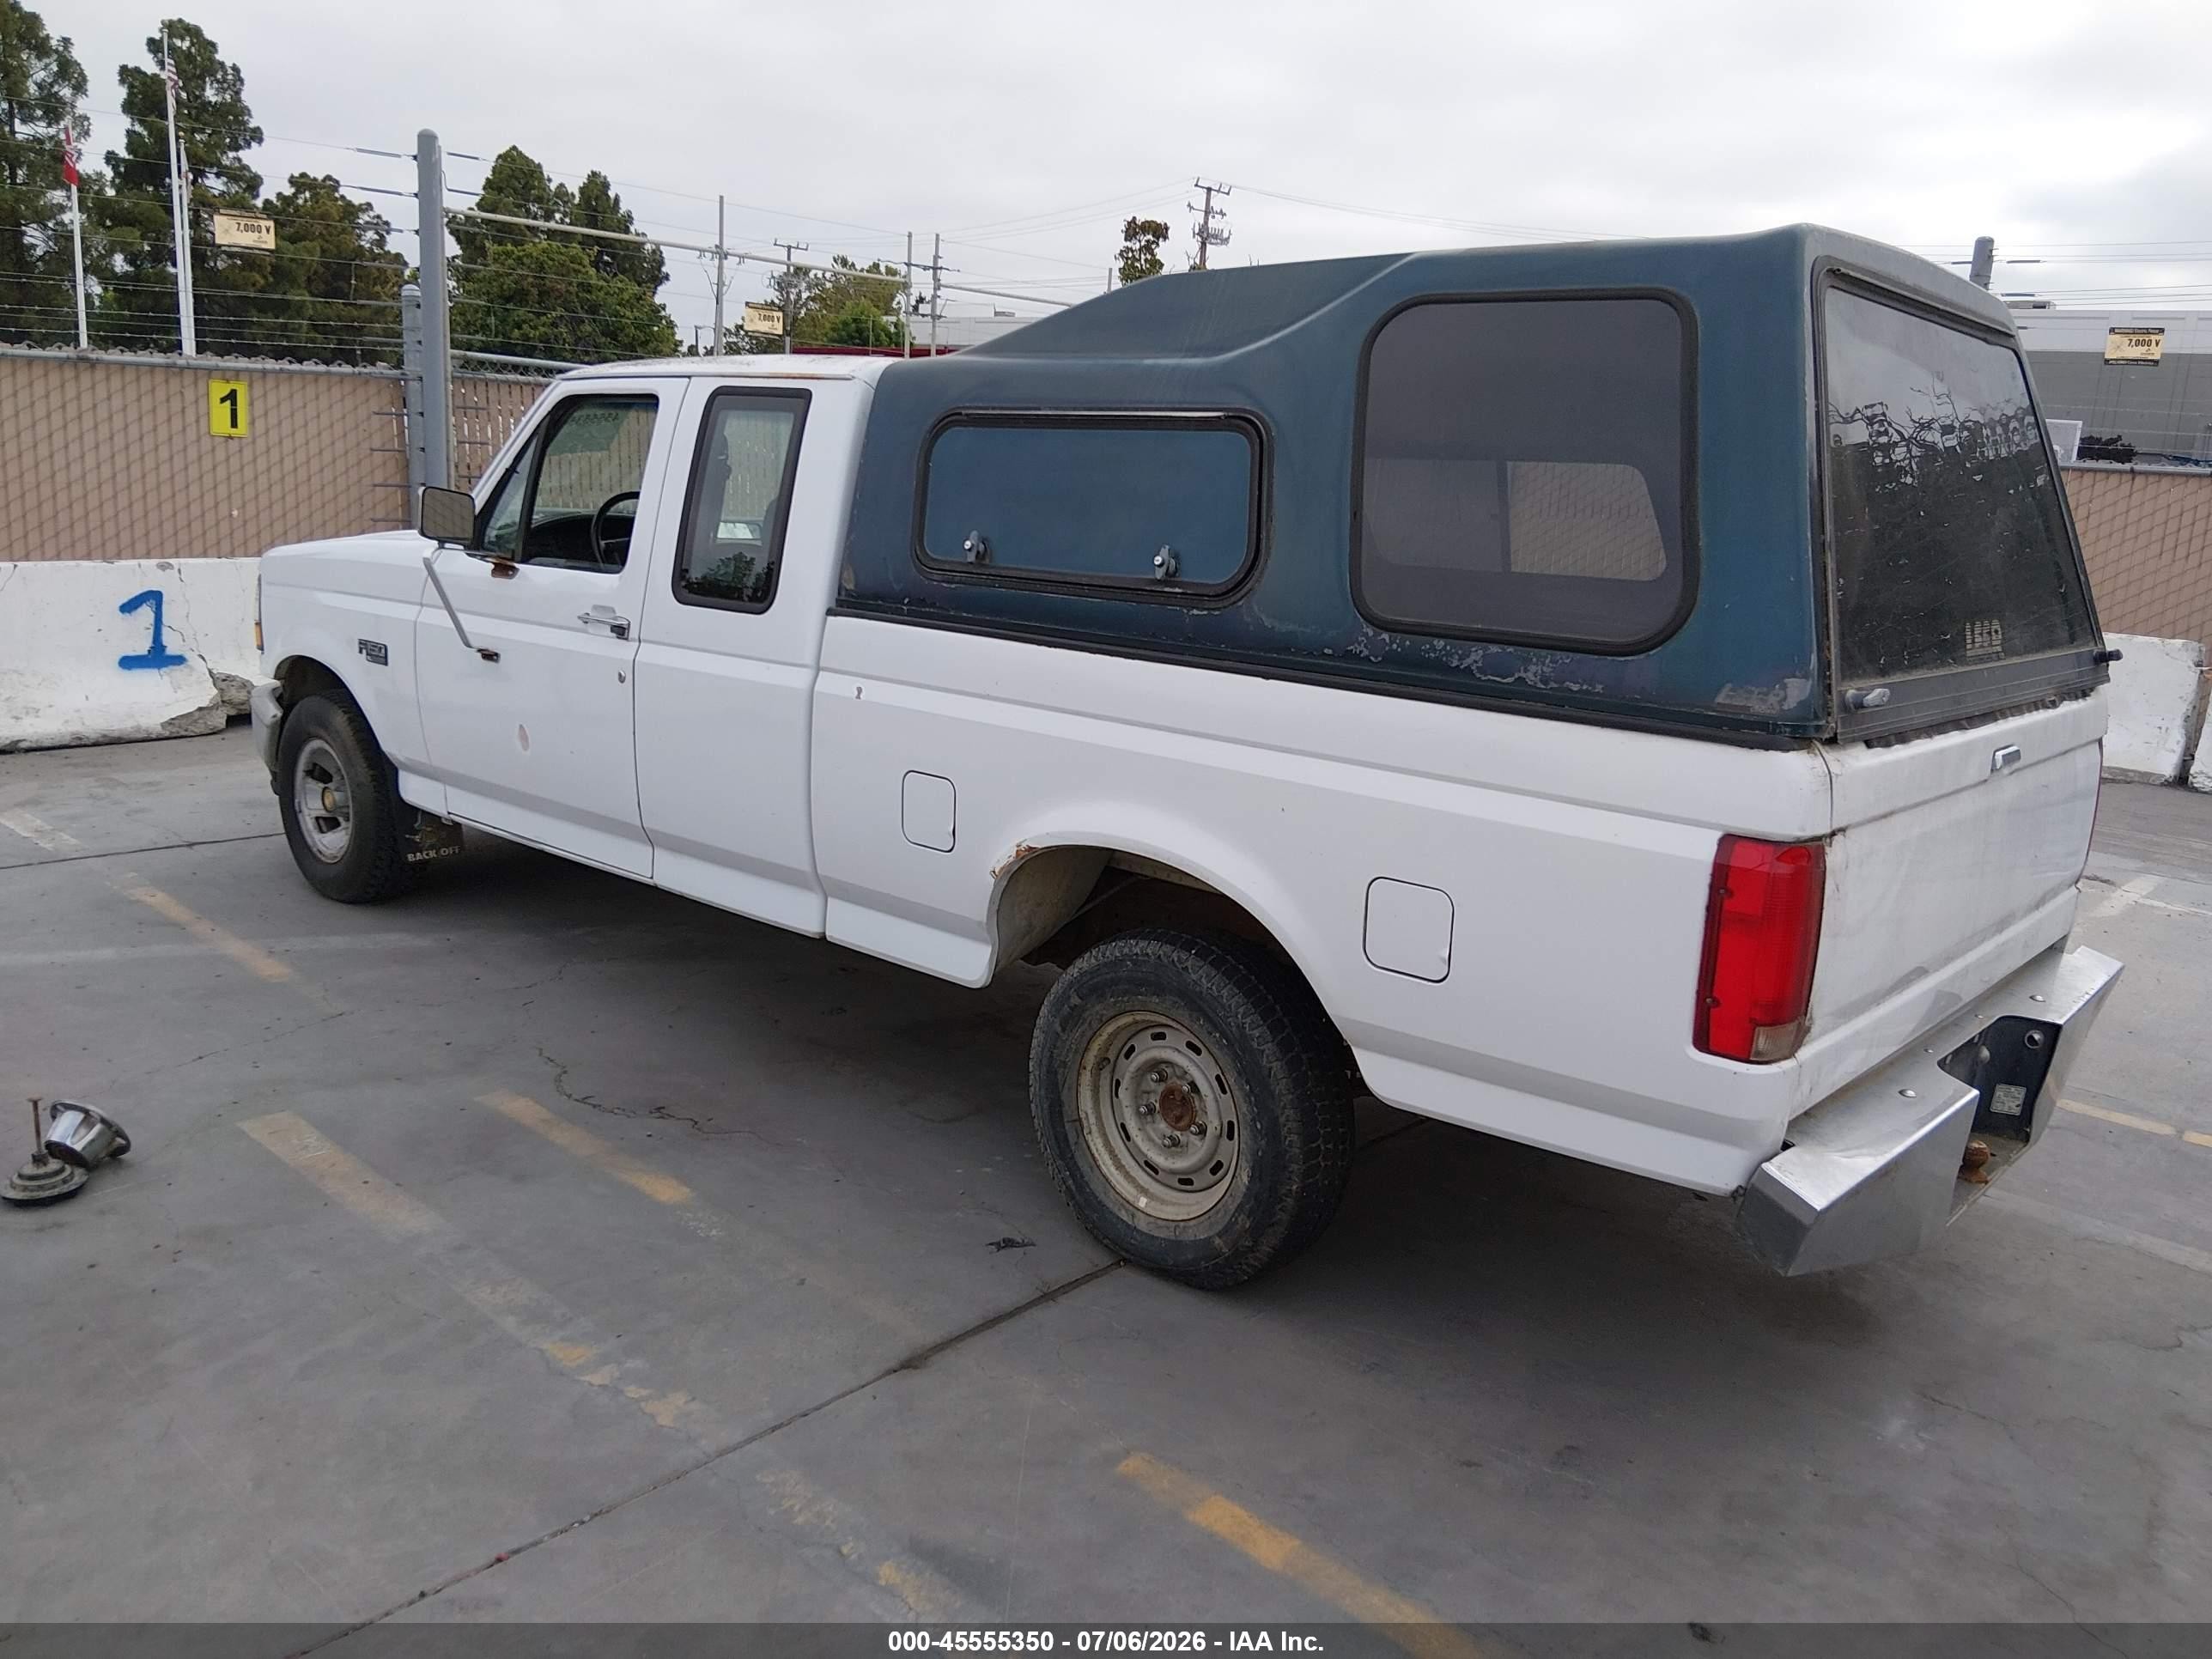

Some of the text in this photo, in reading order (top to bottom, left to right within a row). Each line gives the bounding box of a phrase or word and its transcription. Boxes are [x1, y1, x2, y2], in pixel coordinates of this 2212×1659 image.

[235, 222, 271, 235] 7,000 V
[757, 313, 781, 324] 7,000 V
[2127, 337, 2161, 349] 7,000 V
[219, 388, 239, 429] 1
[118, 589, 189, 670] 1
[406, 846, 460, 861] BACK OFF
